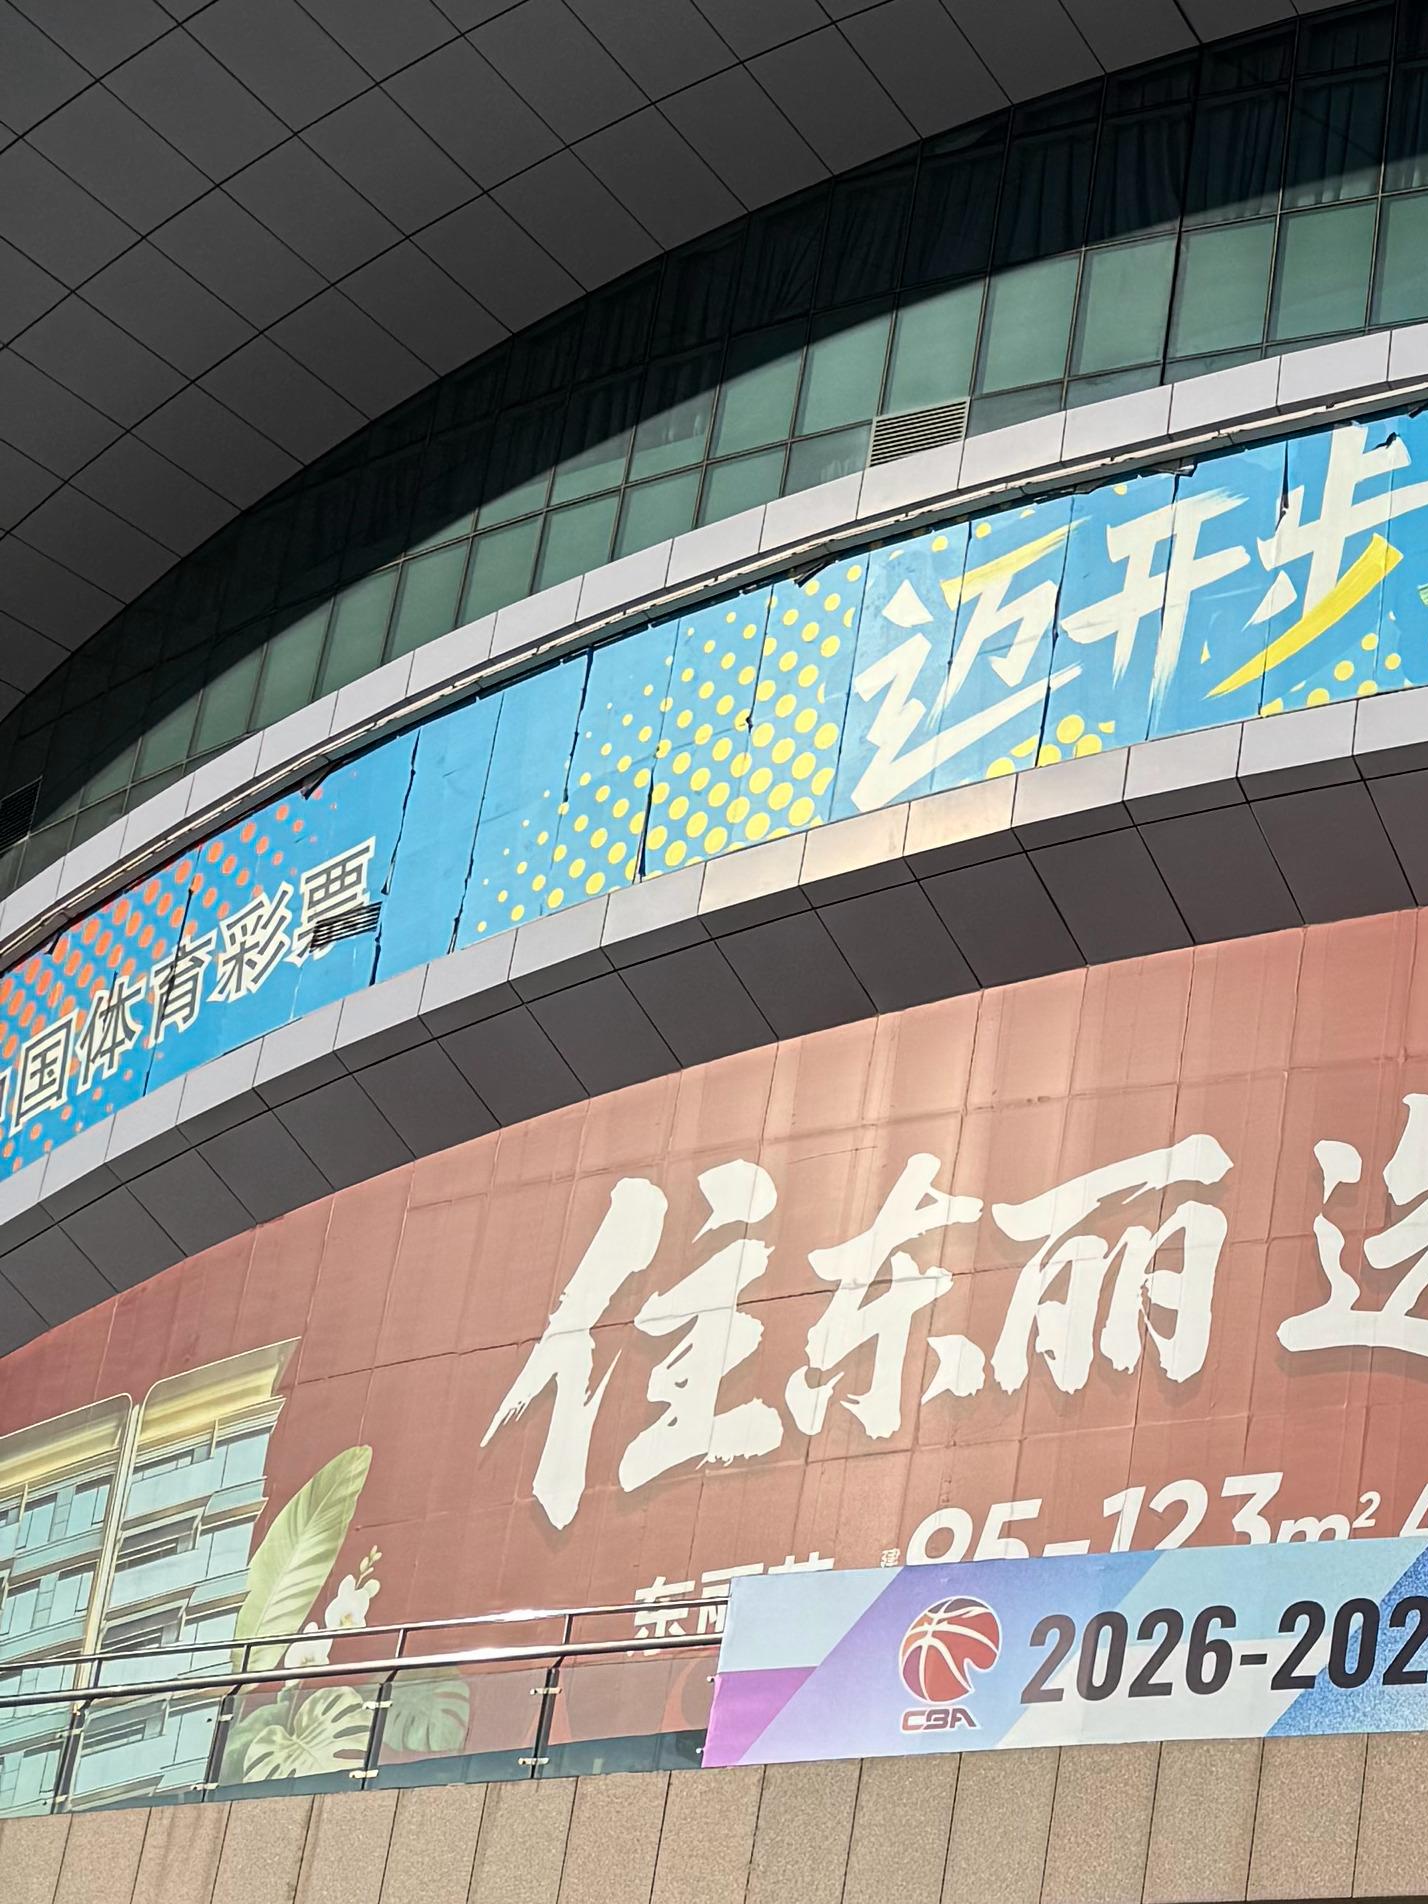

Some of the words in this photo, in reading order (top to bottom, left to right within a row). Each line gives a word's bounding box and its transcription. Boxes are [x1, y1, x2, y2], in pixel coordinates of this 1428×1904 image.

[480, 1132, 1234, 1531] 住东丽
[901, 1707, 978, 1732] CBA
